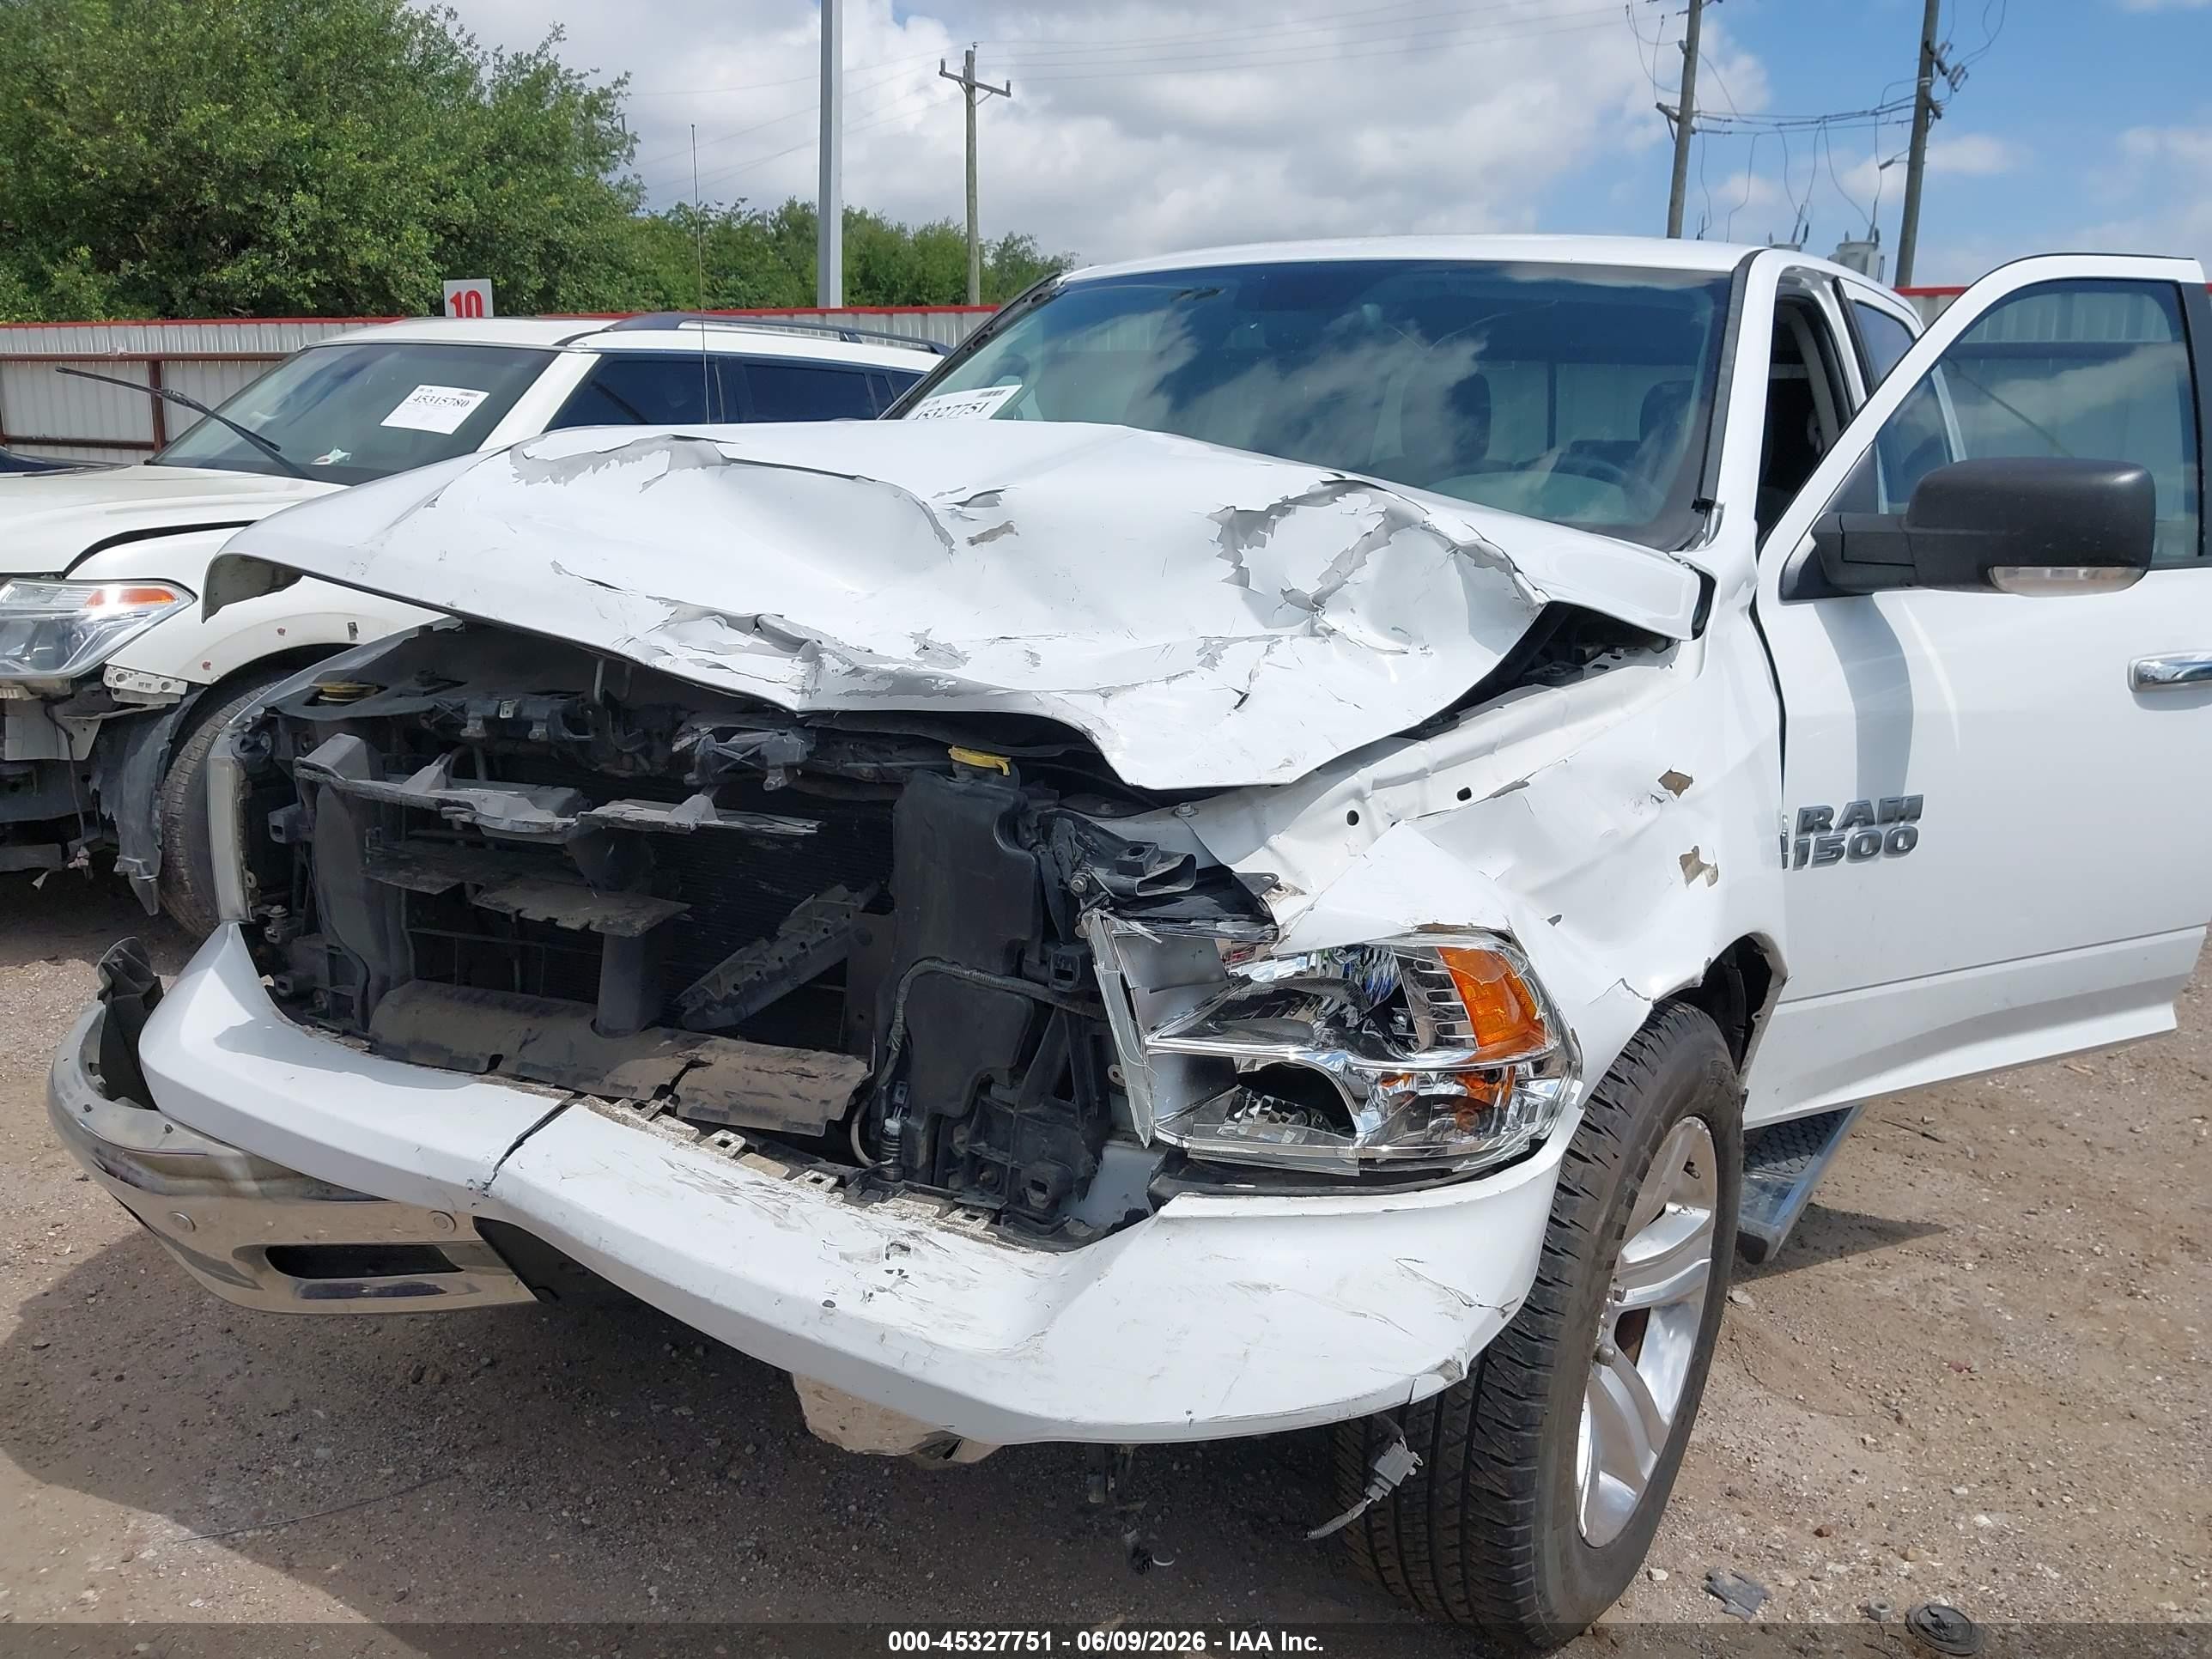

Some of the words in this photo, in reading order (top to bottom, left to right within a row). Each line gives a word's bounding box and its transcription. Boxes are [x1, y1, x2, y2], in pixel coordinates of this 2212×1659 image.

[450, 290, 483, 318] 10
[1796, 795, 1923, 835] RAM
[1793, 826, 1918, 869] 1500
